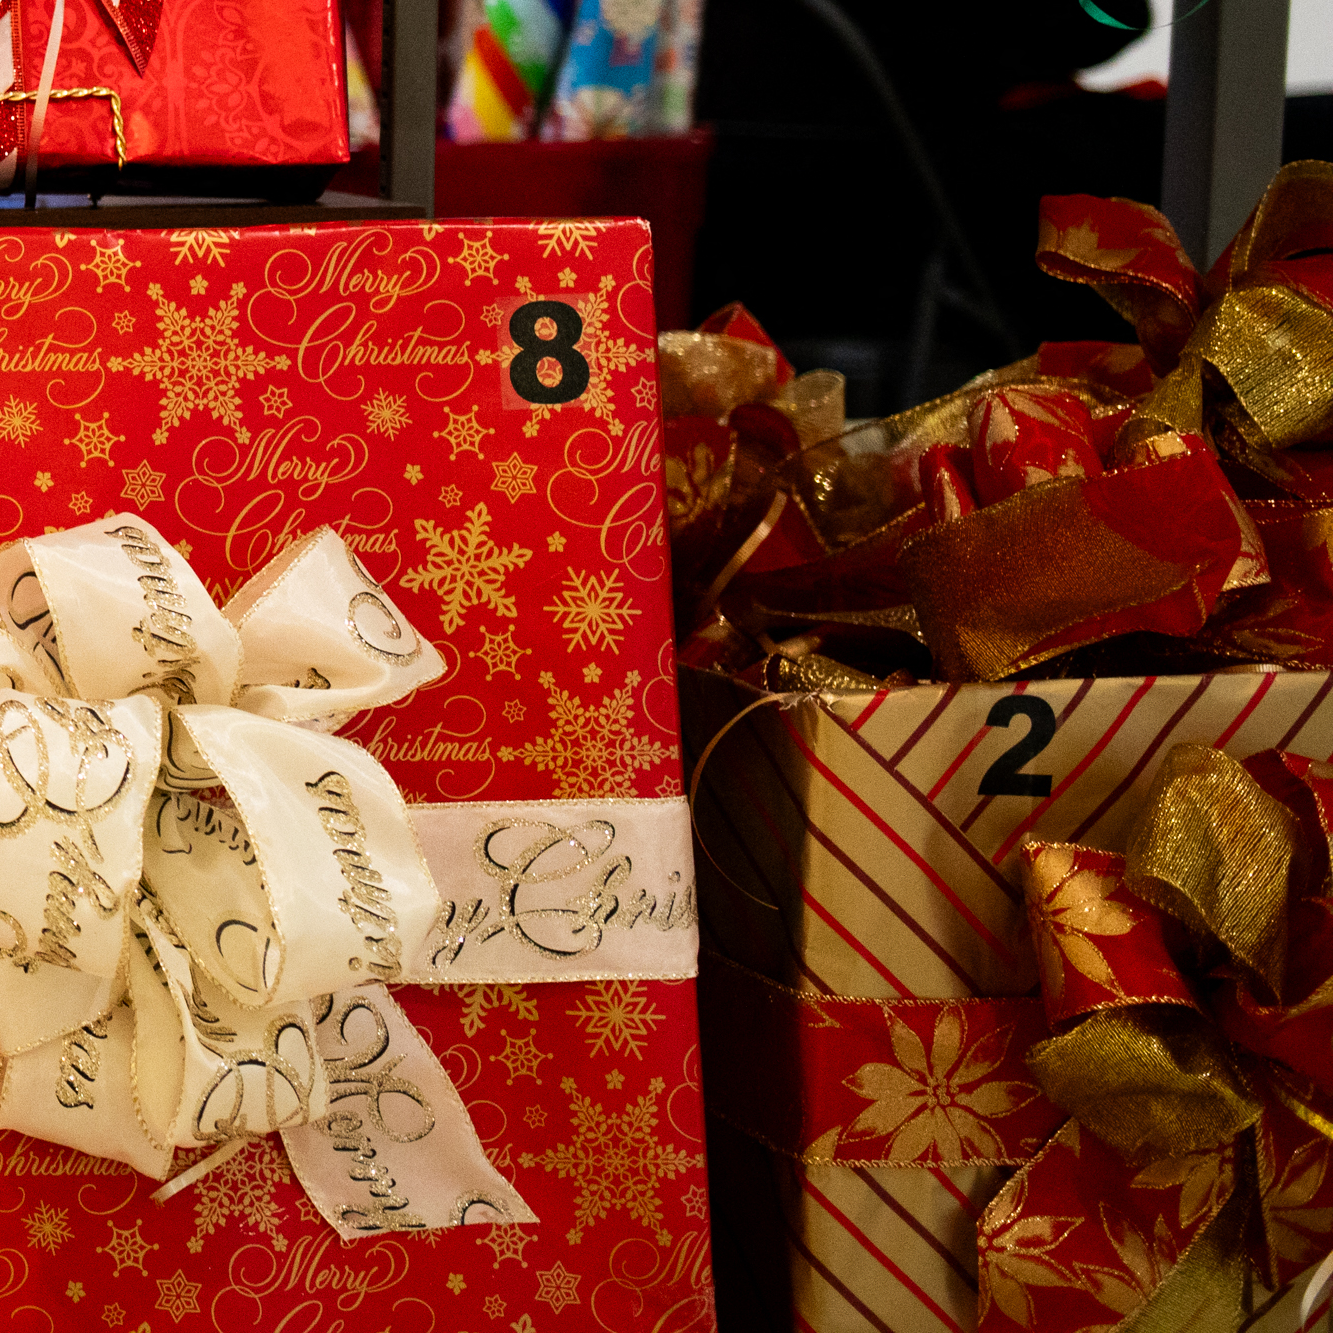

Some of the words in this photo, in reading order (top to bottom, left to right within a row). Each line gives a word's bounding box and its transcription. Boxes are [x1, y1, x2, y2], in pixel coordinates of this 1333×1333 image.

[265, 228, 440, 314] Merry
[247, 288, 474, 402] Christmas
[509, 300, 590, 405] 8
[192, 415, 369, 501] Merry
[977, 694, 1058, 798] 2
[229, 1230, 410, 1312] Merry
